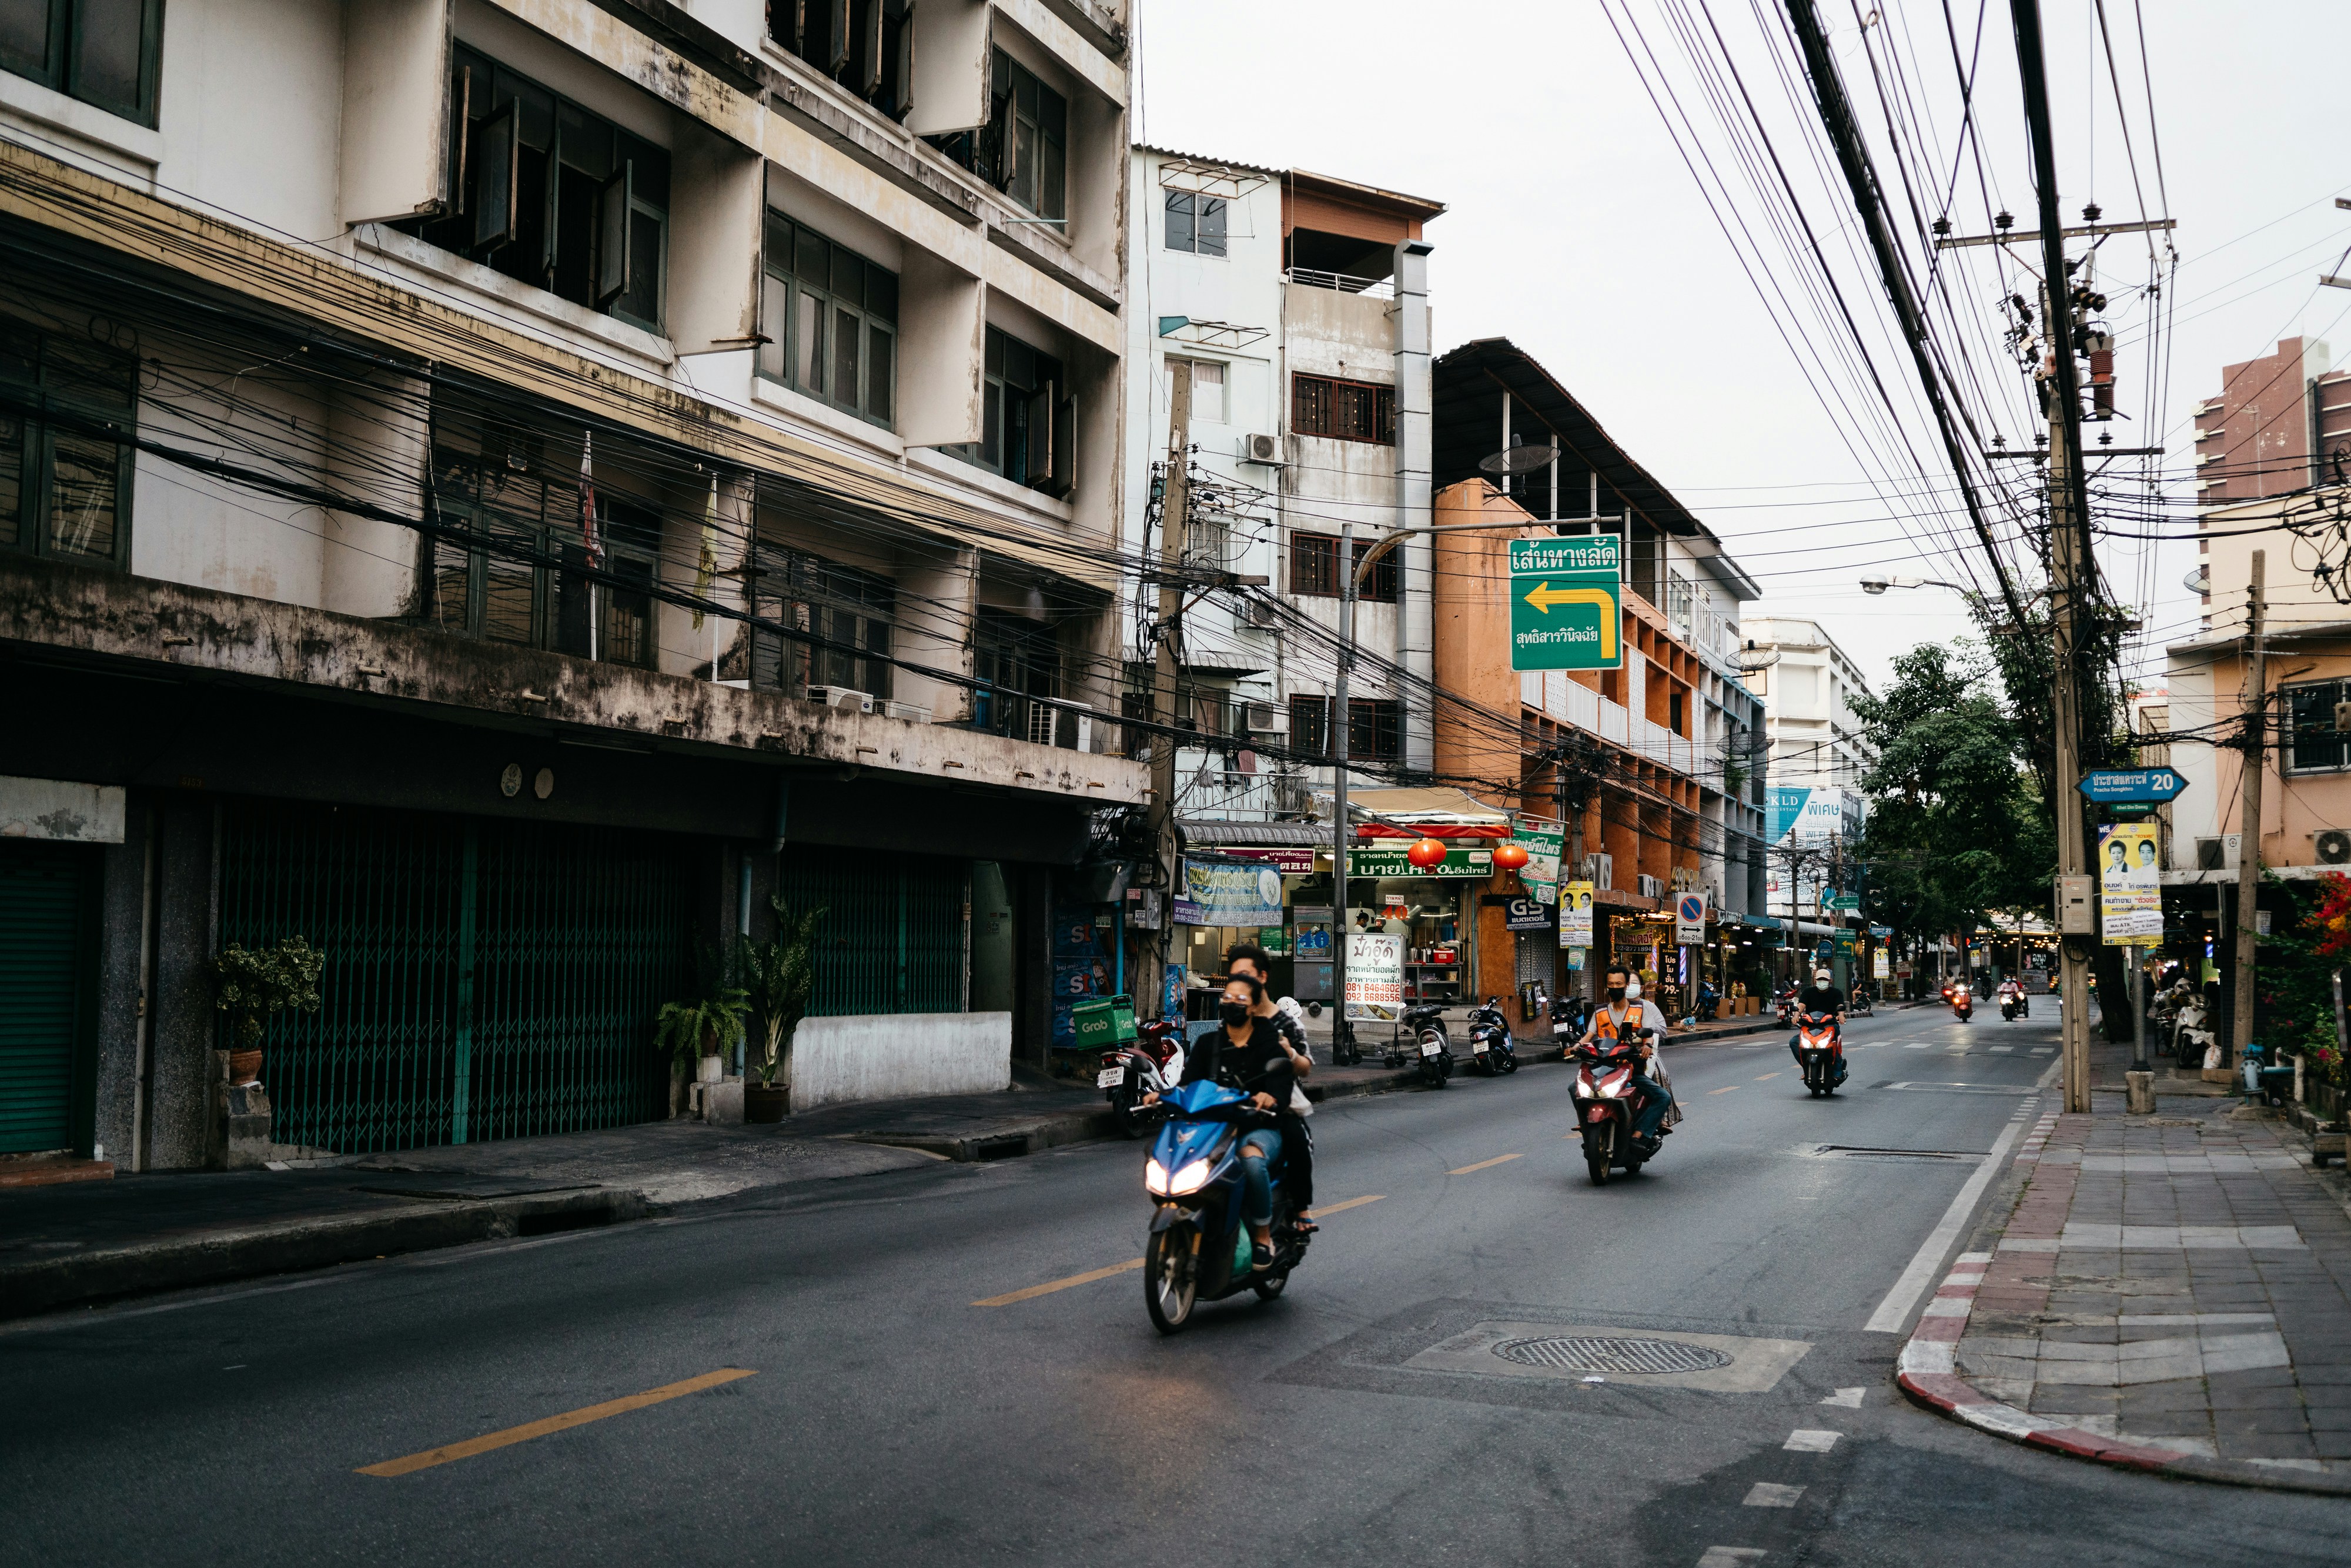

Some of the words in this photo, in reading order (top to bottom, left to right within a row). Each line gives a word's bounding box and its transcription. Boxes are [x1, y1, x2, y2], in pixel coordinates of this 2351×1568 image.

[1512, 539, 1616, 570] เส้นทางลัด
[1516, 626, 1598, 648] สุทธิสารวินิจฉัย
[2093, 772, 2147, 785] ประชาสงเคราะห์
[2152, 774, 2173, 790] 20
[1808, 801, 1840, 815] พิเศษ
[2099, 825, 2110, 833] ฟรี
[1382, 905, 1409, 920] 40
[1511, 899, 1544, 915] GS
[1055, 923, 1092, 945] est
[1299, 930, 1330, 948] 40
[1665, 955, 1676, 964] โปร
[1346, 964, 1400, 975] ราดหน้ายอดผัก
[1666, 965, 1674, 973] โม
[1054, 973, 1092, 996] est
[1347, 975, 1400, 984] อาหารตามสั่ง
[1665, 974, 1674, 983] ชั่น
[1346, 982, 1361, 991] 081
[1365, 984, 1400, 992] 6464602
[1346, 992, 1361, 1001] 092
[1365, 992, 1400, 1002] 6688556
[1347, 1007, 1364, 1016] est
[1053, 1015, 1076, 1036] es
[1082, 1019, 1108, 1033] Grab
[1121, 1019, 1132, 1029] Grab
